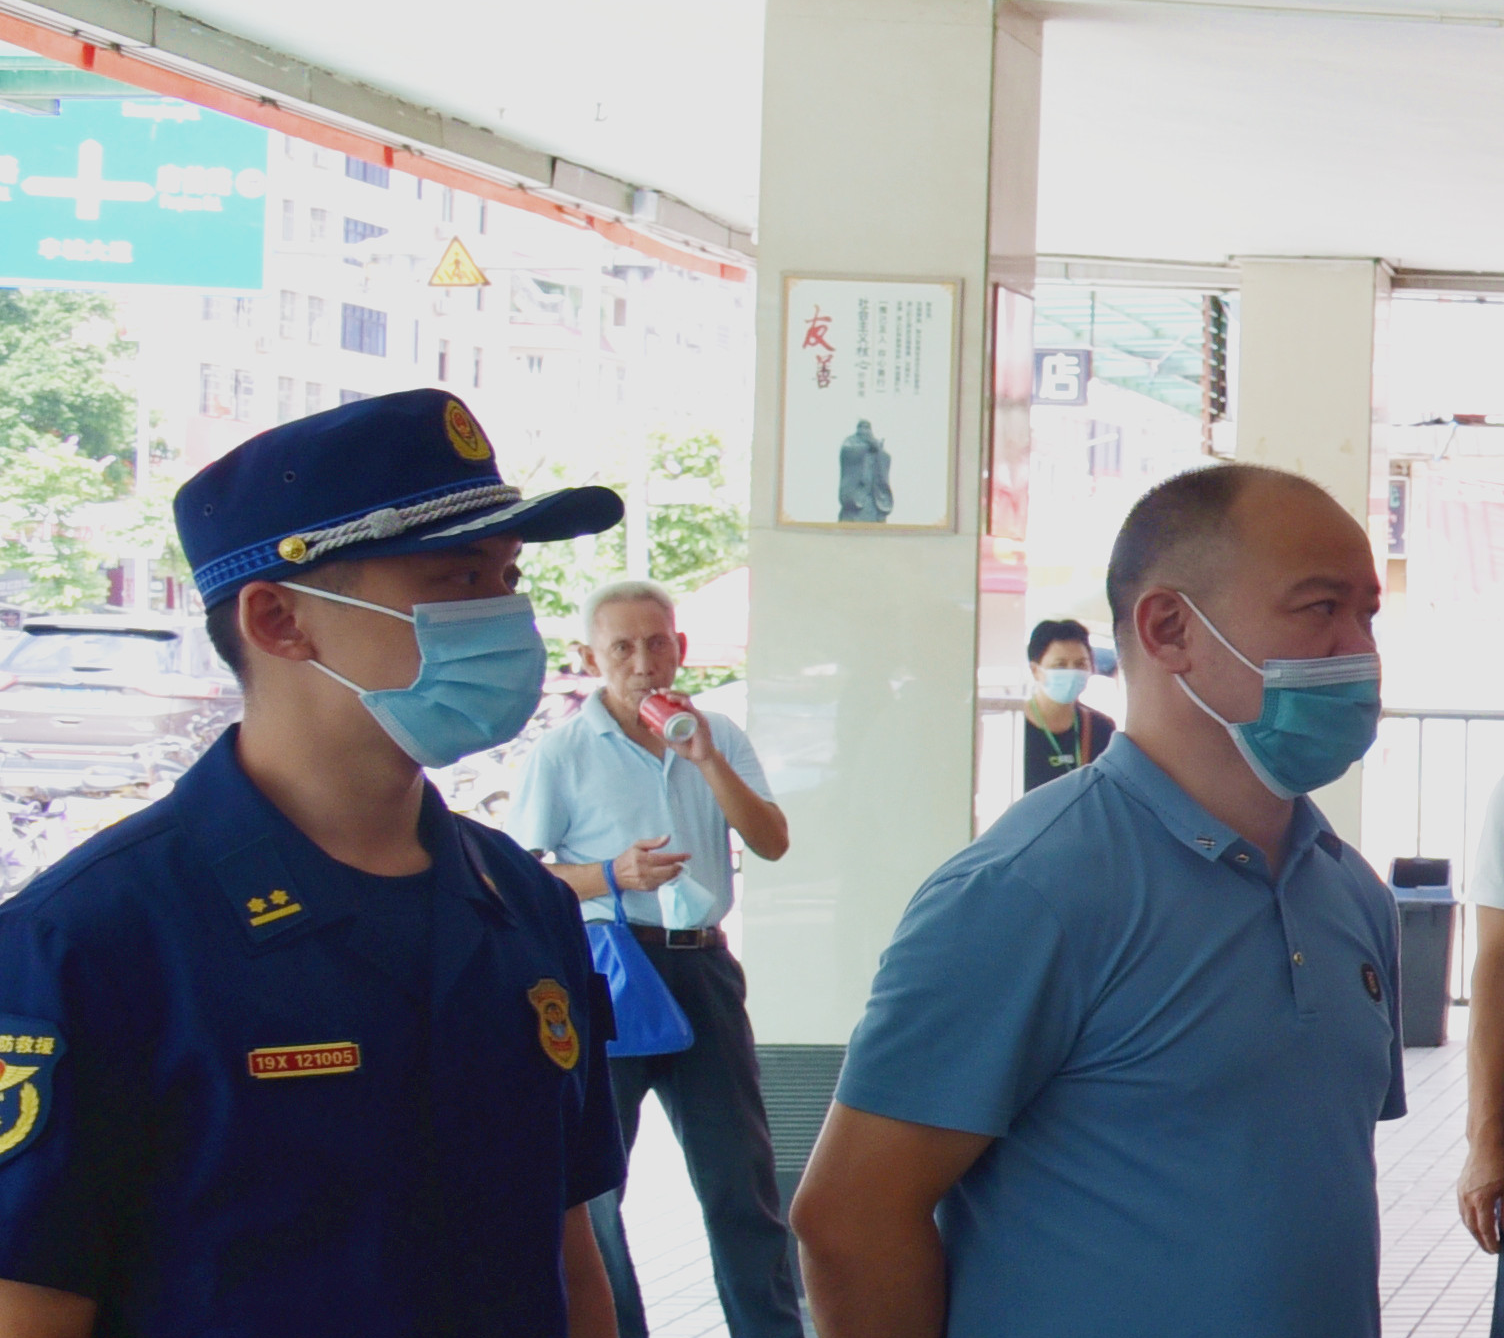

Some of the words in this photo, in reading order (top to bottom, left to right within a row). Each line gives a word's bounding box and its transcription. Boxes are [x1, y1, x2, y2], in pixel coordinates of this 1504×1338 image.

[802, 304, 838, 389] 友善
[255, 1055, 288, 1071] 19X
[294, 1049, 354, 1068] 121005
